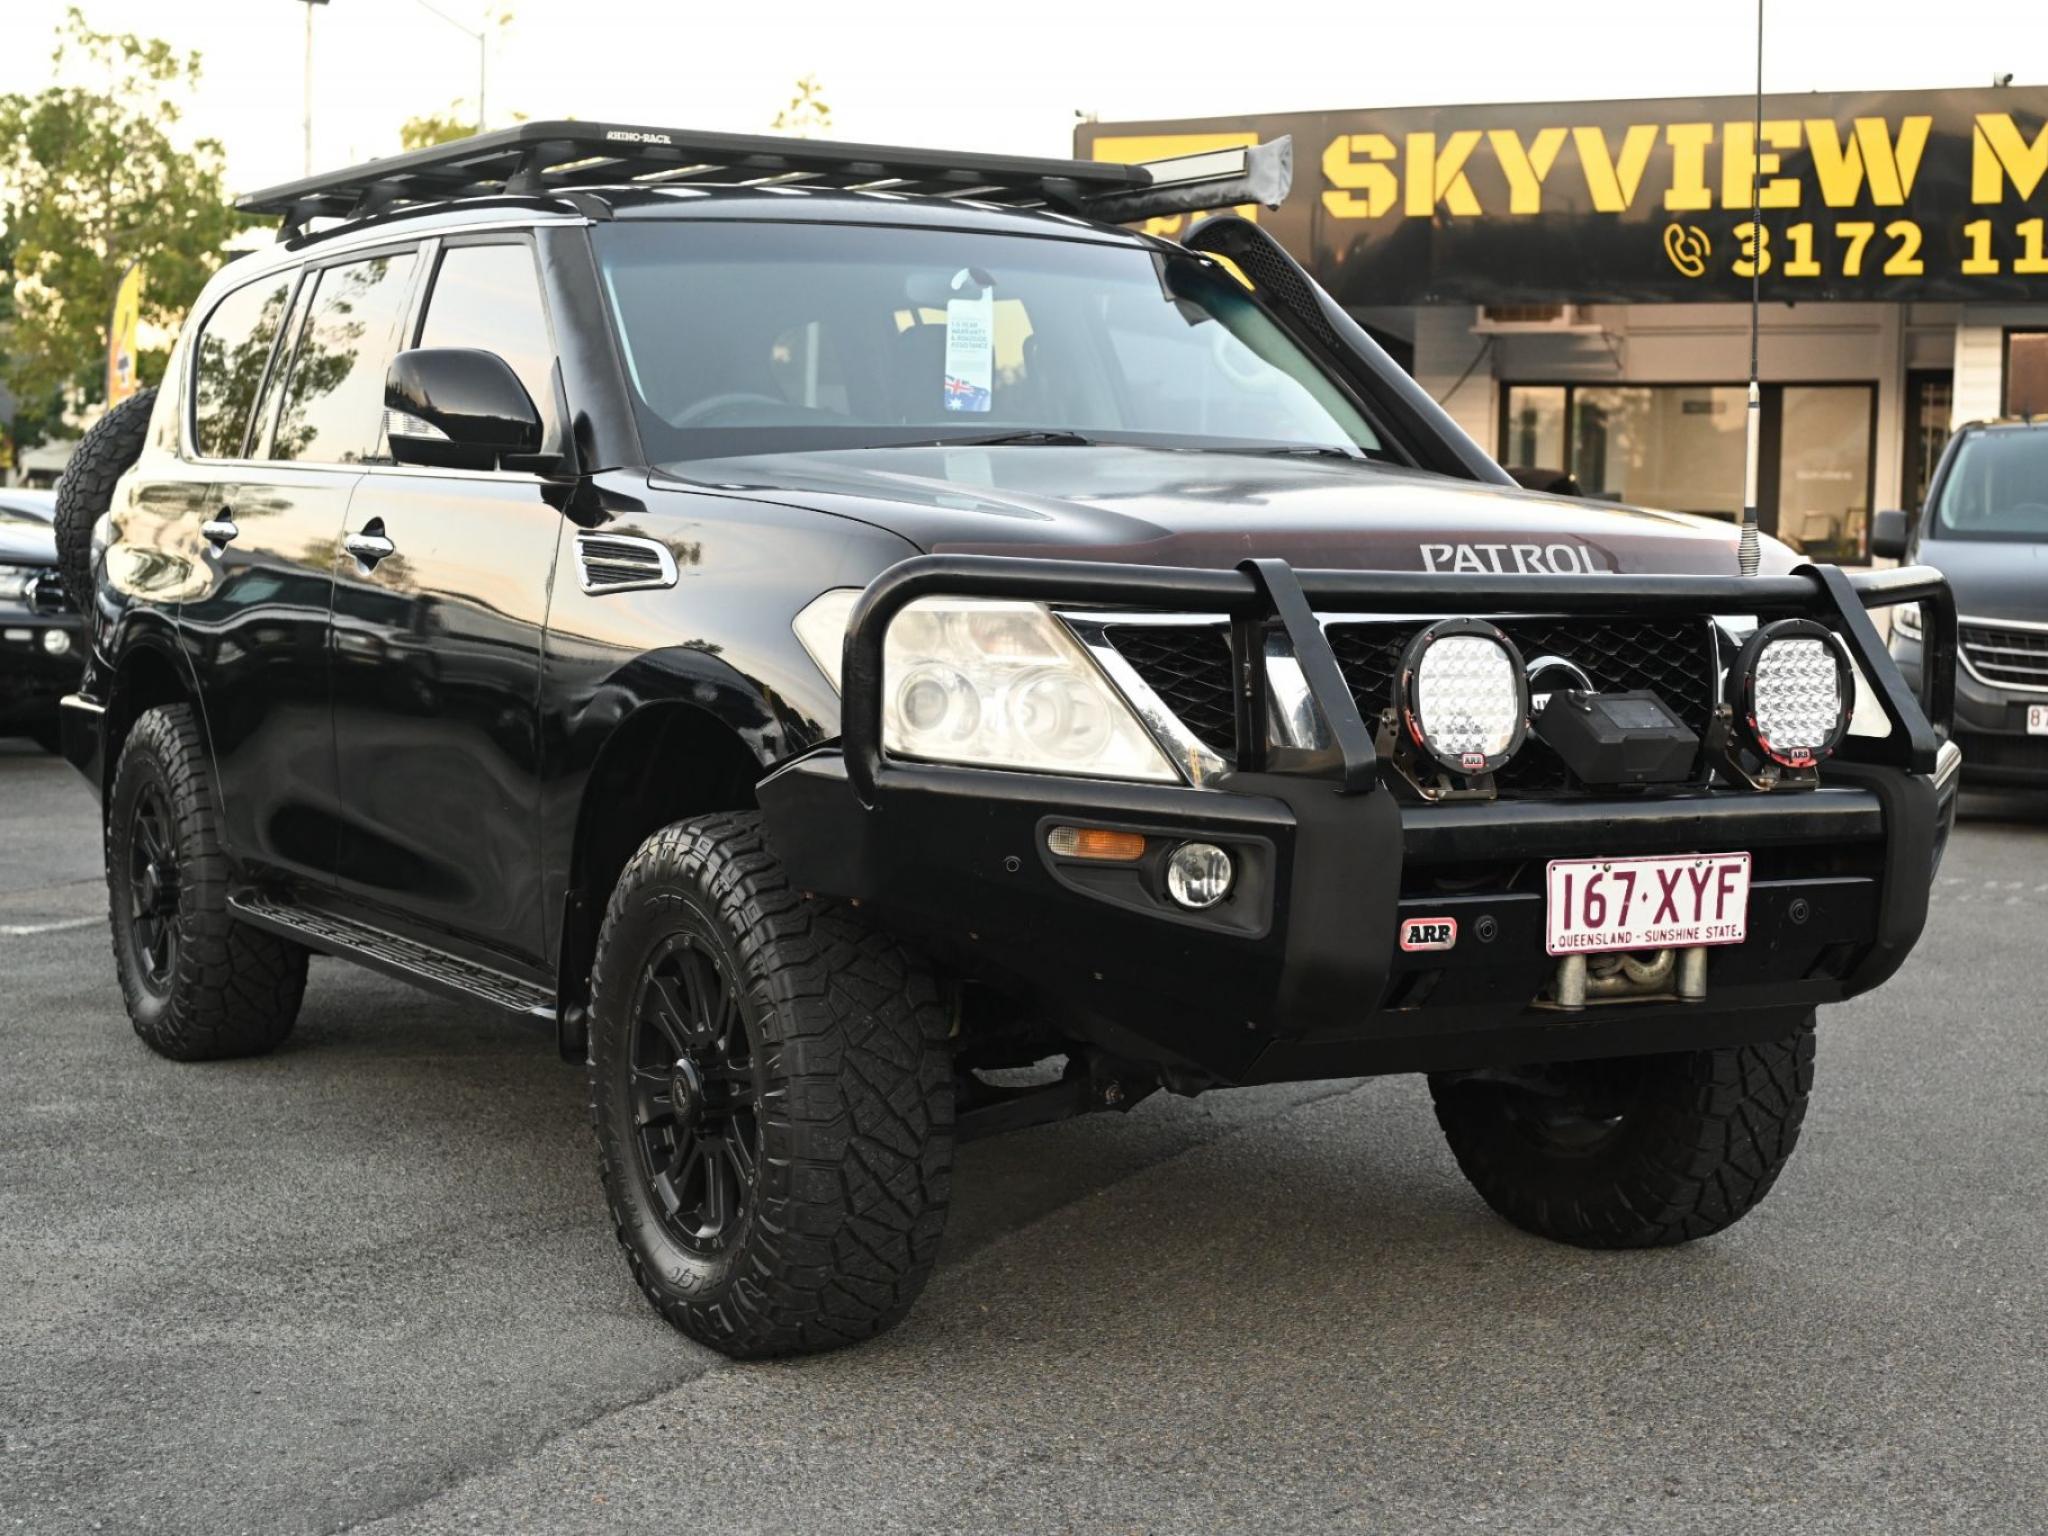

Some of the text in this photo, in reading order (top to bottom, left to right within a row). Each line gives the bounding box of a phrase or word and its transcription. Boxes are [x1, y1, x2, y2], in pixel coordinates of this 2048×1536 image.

[1321, 115, 1933, 219] SKYVIEW
[1731, 217, 2048, 278] 3172 11
[1419, 543, 1615, 575] PATROL
[1558, 930, 1632, 948] QUEENSLAND
[1644, 926, 1700, 942] SUNSHINE
[1705, 923, 1738, 939] STATE
